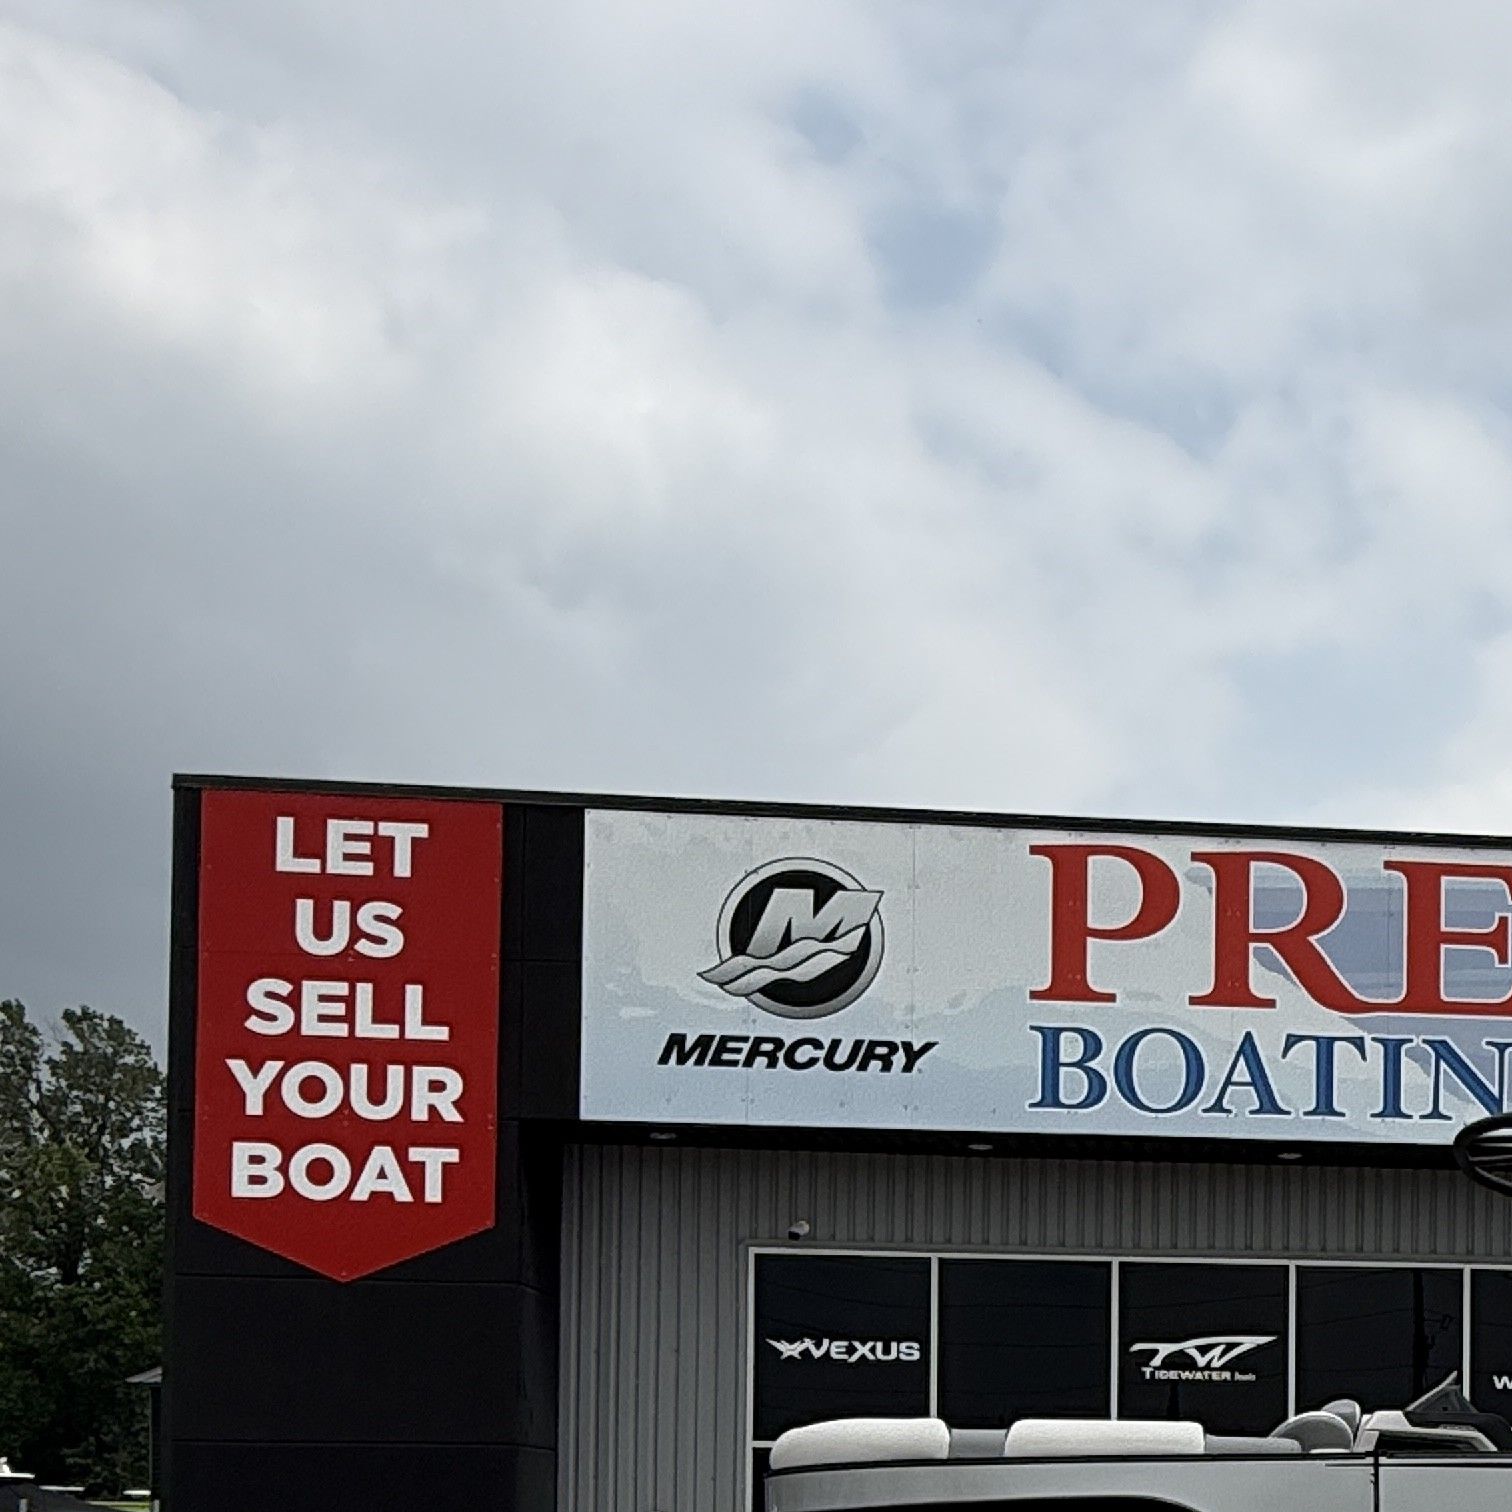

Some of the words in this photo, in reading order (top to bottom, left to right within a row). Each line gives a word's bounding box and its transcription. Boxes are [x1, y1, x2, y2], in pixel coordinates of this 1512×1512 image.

[275, 816, 429, 879] LET
[294, 898, 405, 959] US
[244, 978, 450, 1042] SELL
[657, 1033, 940, 1074] MERCURY
[226, 1059, 465, 1123] YOUR
[229, 1141, 461, 1204] BOAT
[806, 1337, 921, 1363] VEXUS
[1141, 1367, 1231, 1381] TIDEWATER
